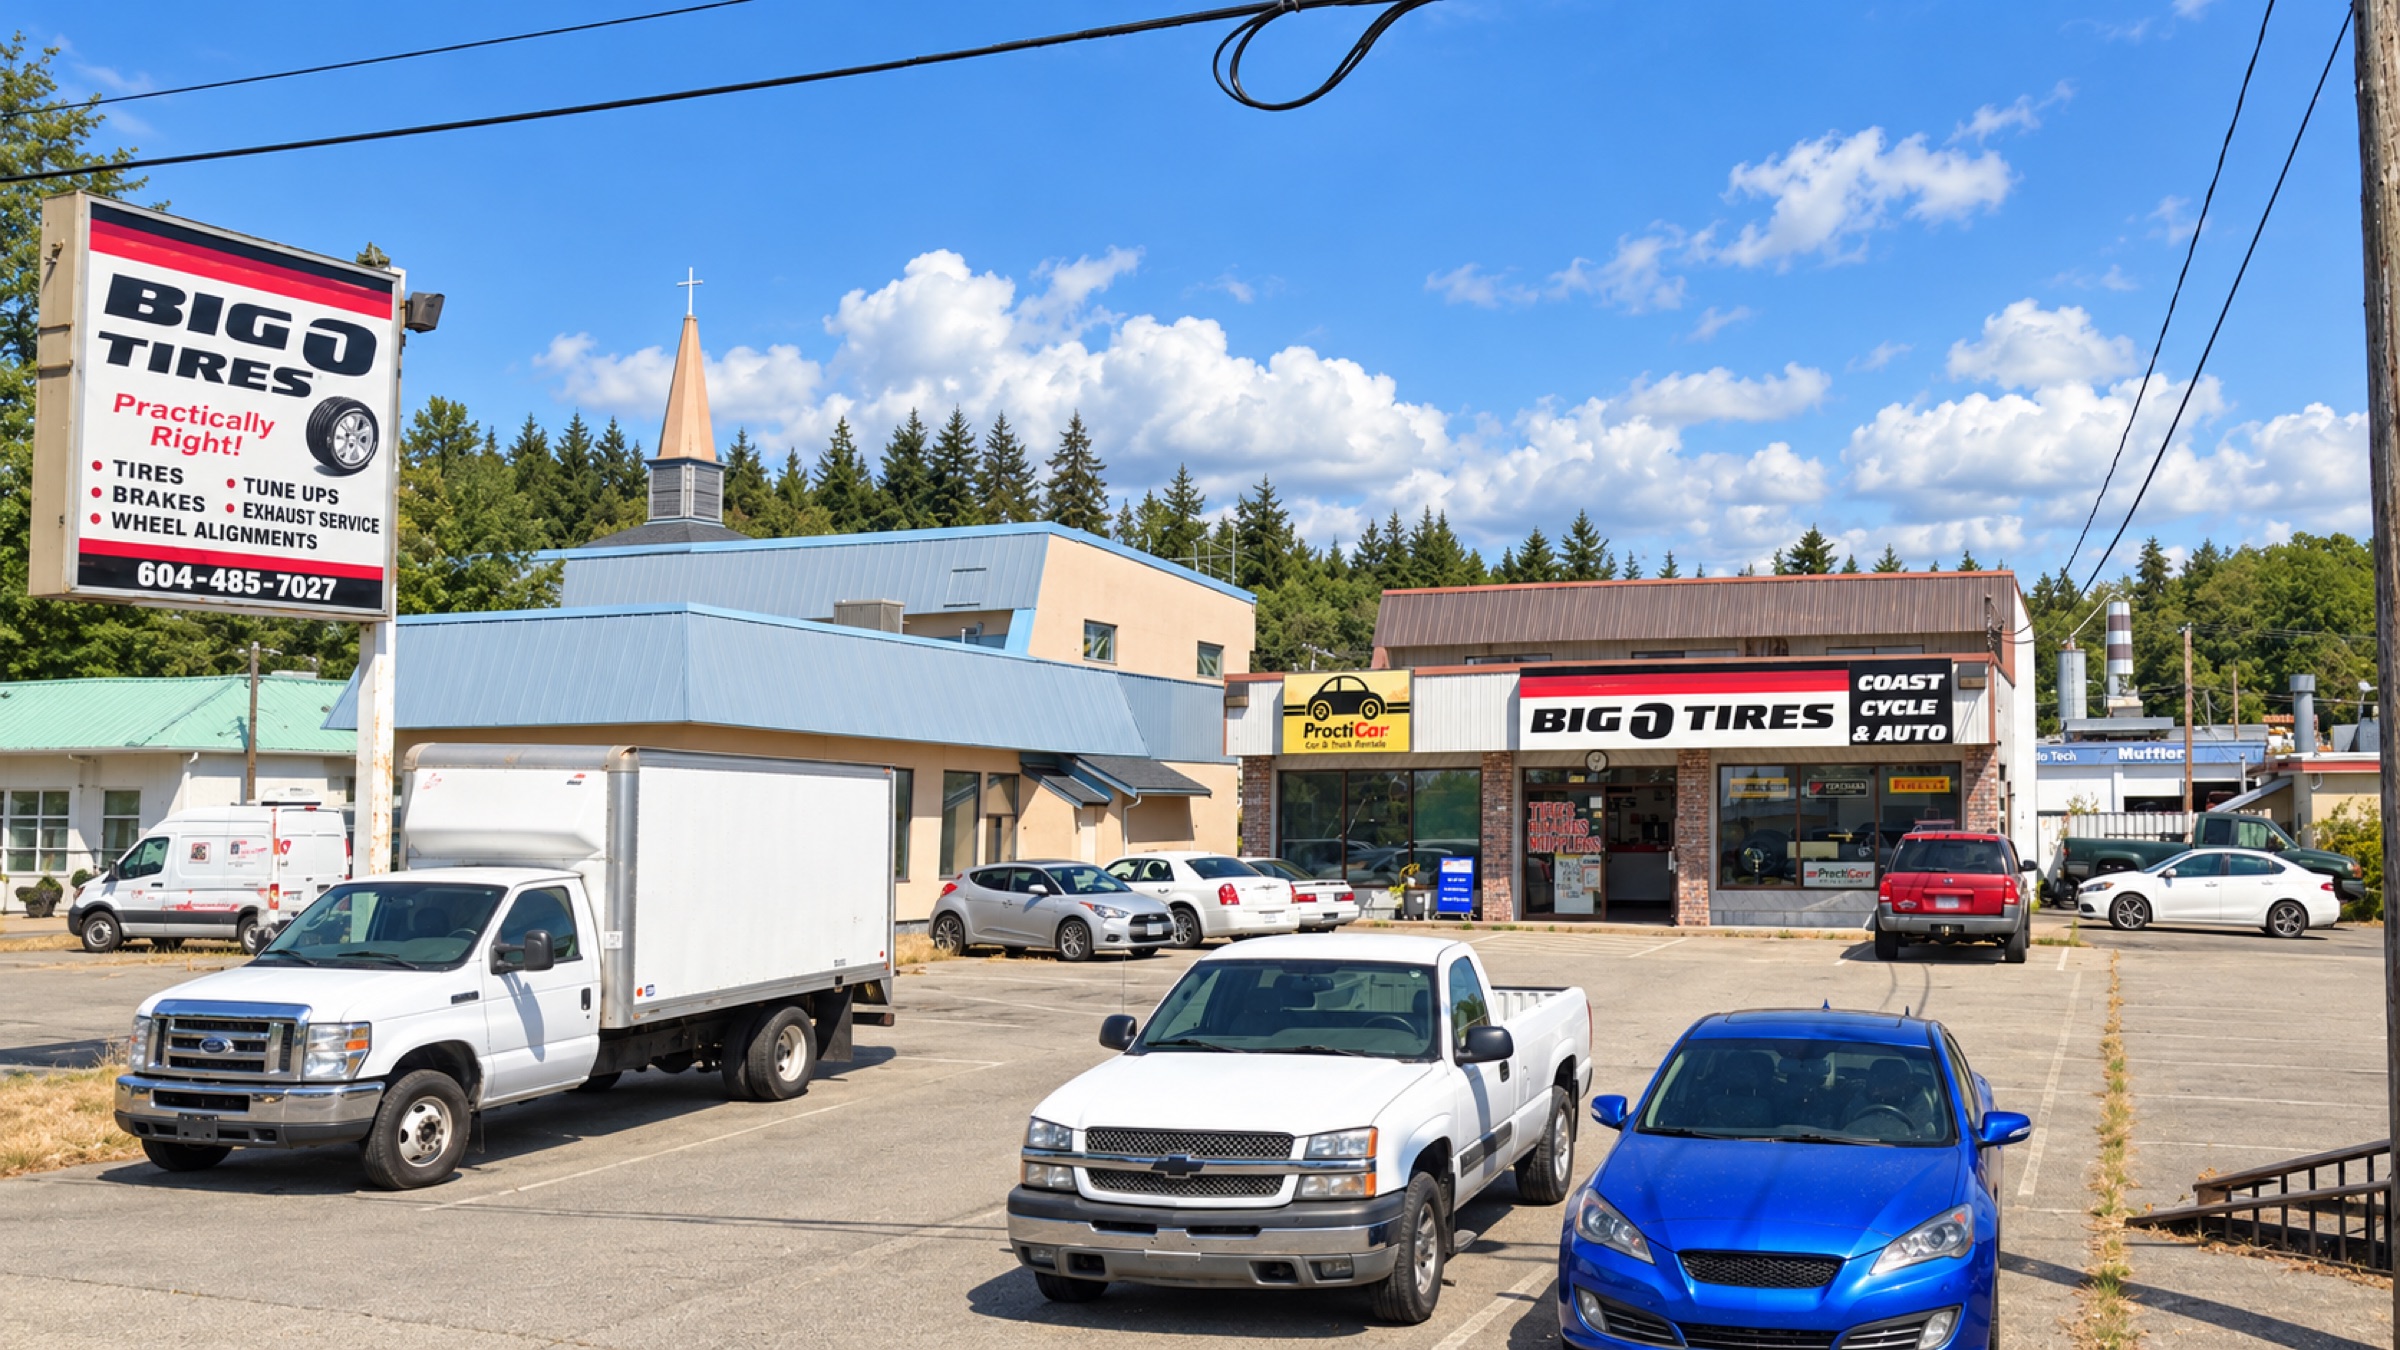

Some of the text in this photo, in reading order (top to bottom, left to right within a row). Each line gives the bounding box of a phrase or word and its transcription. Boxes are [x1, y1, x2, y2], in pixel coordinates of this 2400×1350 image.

[104, 273, 378, 377] BIG O
[99, 331, 314, 398] TIRES
[113, 393, 275, 439] Practically
[150, 426, 243, 457] Right!
[113, 459, 184, 485] TIRES
[113, 485, 206, 513] BRAKES
[244, 477, 339, 505] TUNE UPS
[112, 512, 318, 550] WHEEL ALIGNMENTS
[243, 502, 380, 535] EXHAUST SERVICE
[137, 561, 337, 600] 604-485-7027
[1858, 673, 1946, 691] COAST
[1530, 703, 1834, 739] BIG O TIRES
[1859, 699, 1939, 717] CYCLE
[1852, 724, 1947, 742] & AUTO
[2050, 750, 2077, 761] Tech
